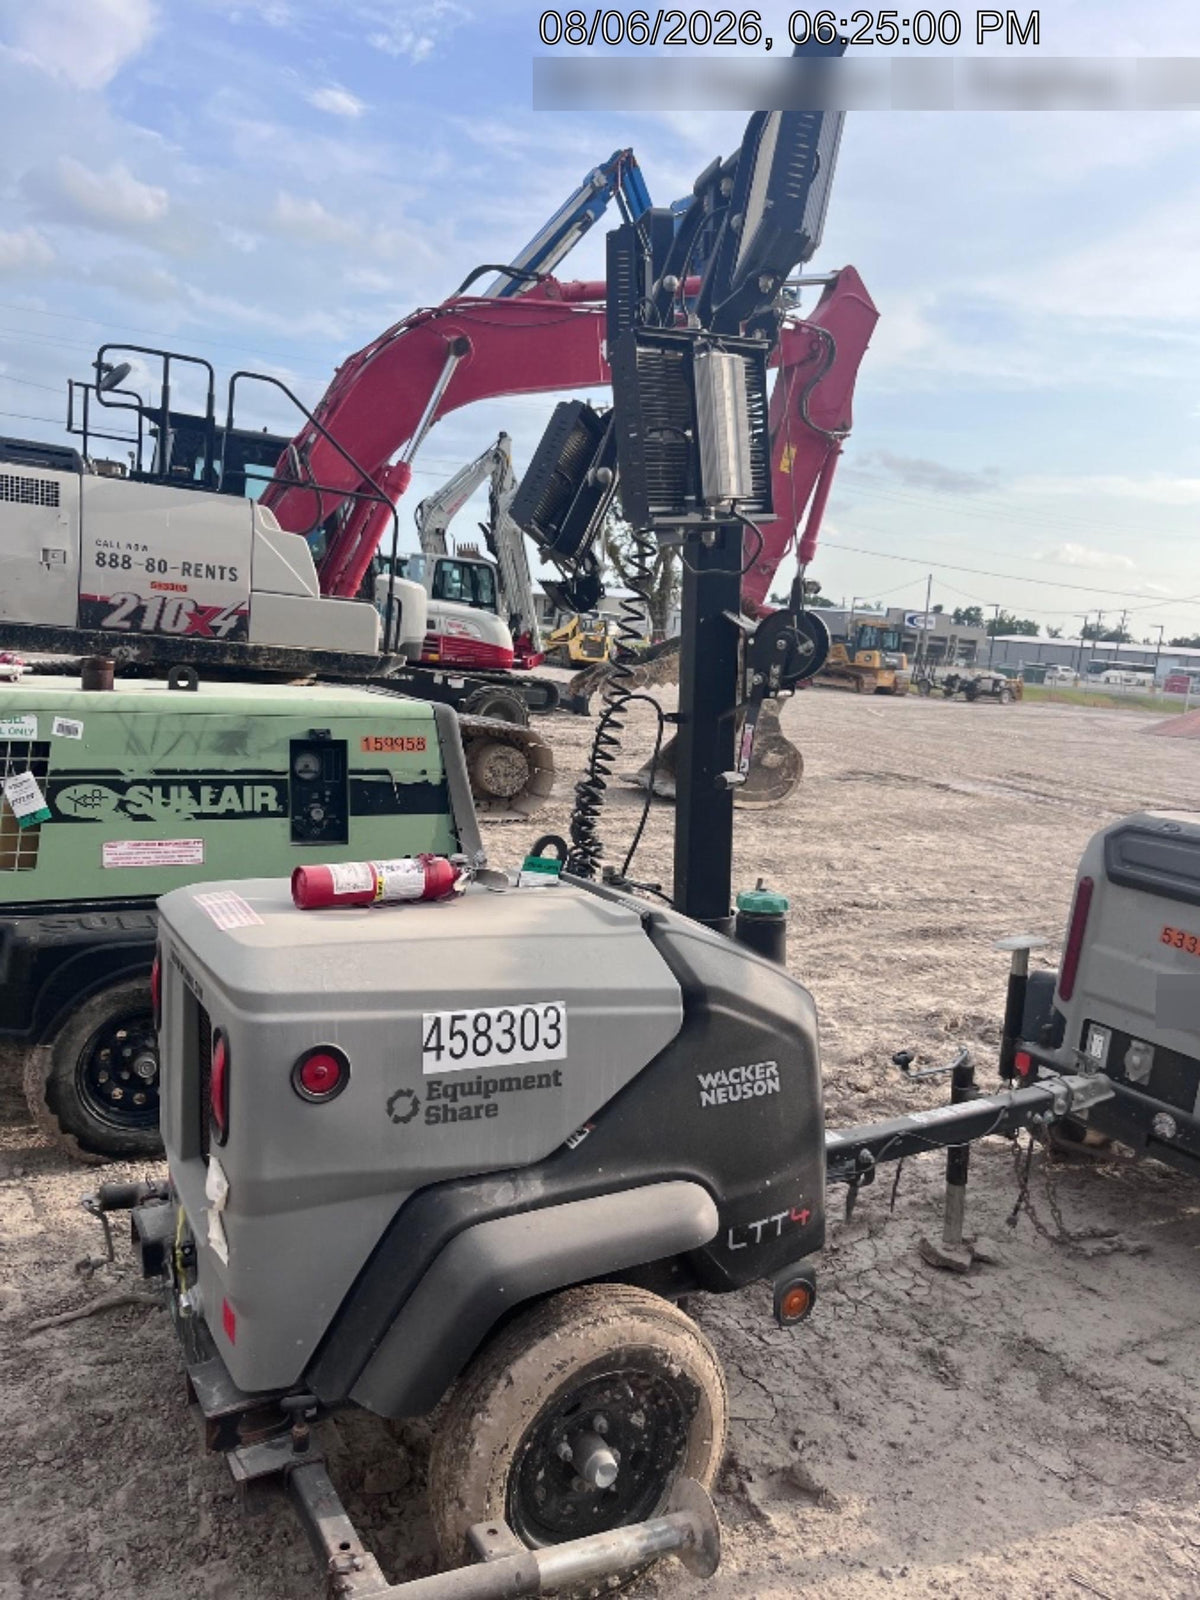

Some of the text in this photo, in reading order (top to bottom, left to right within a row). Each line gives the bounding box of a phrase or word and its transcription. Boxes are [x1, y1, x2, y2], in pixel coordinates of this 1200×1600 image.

[95, 539, 121, 550] CALL
[95, 551, 239, 583] 888-80-RENTS
[8, 726, 35, 737] ONLY
[362, 736, 426, 751] 159958
[1162, 927, 1200, 956] 533
[422, 1006, 562, 1061] 458303
[426, 1069, 562, 1102] Equipment
[697, 1061, 779, 1089] WACKER
[700, 1077, 780, 1107] NEUSON
[425, 1103, 498, 1125] Share
